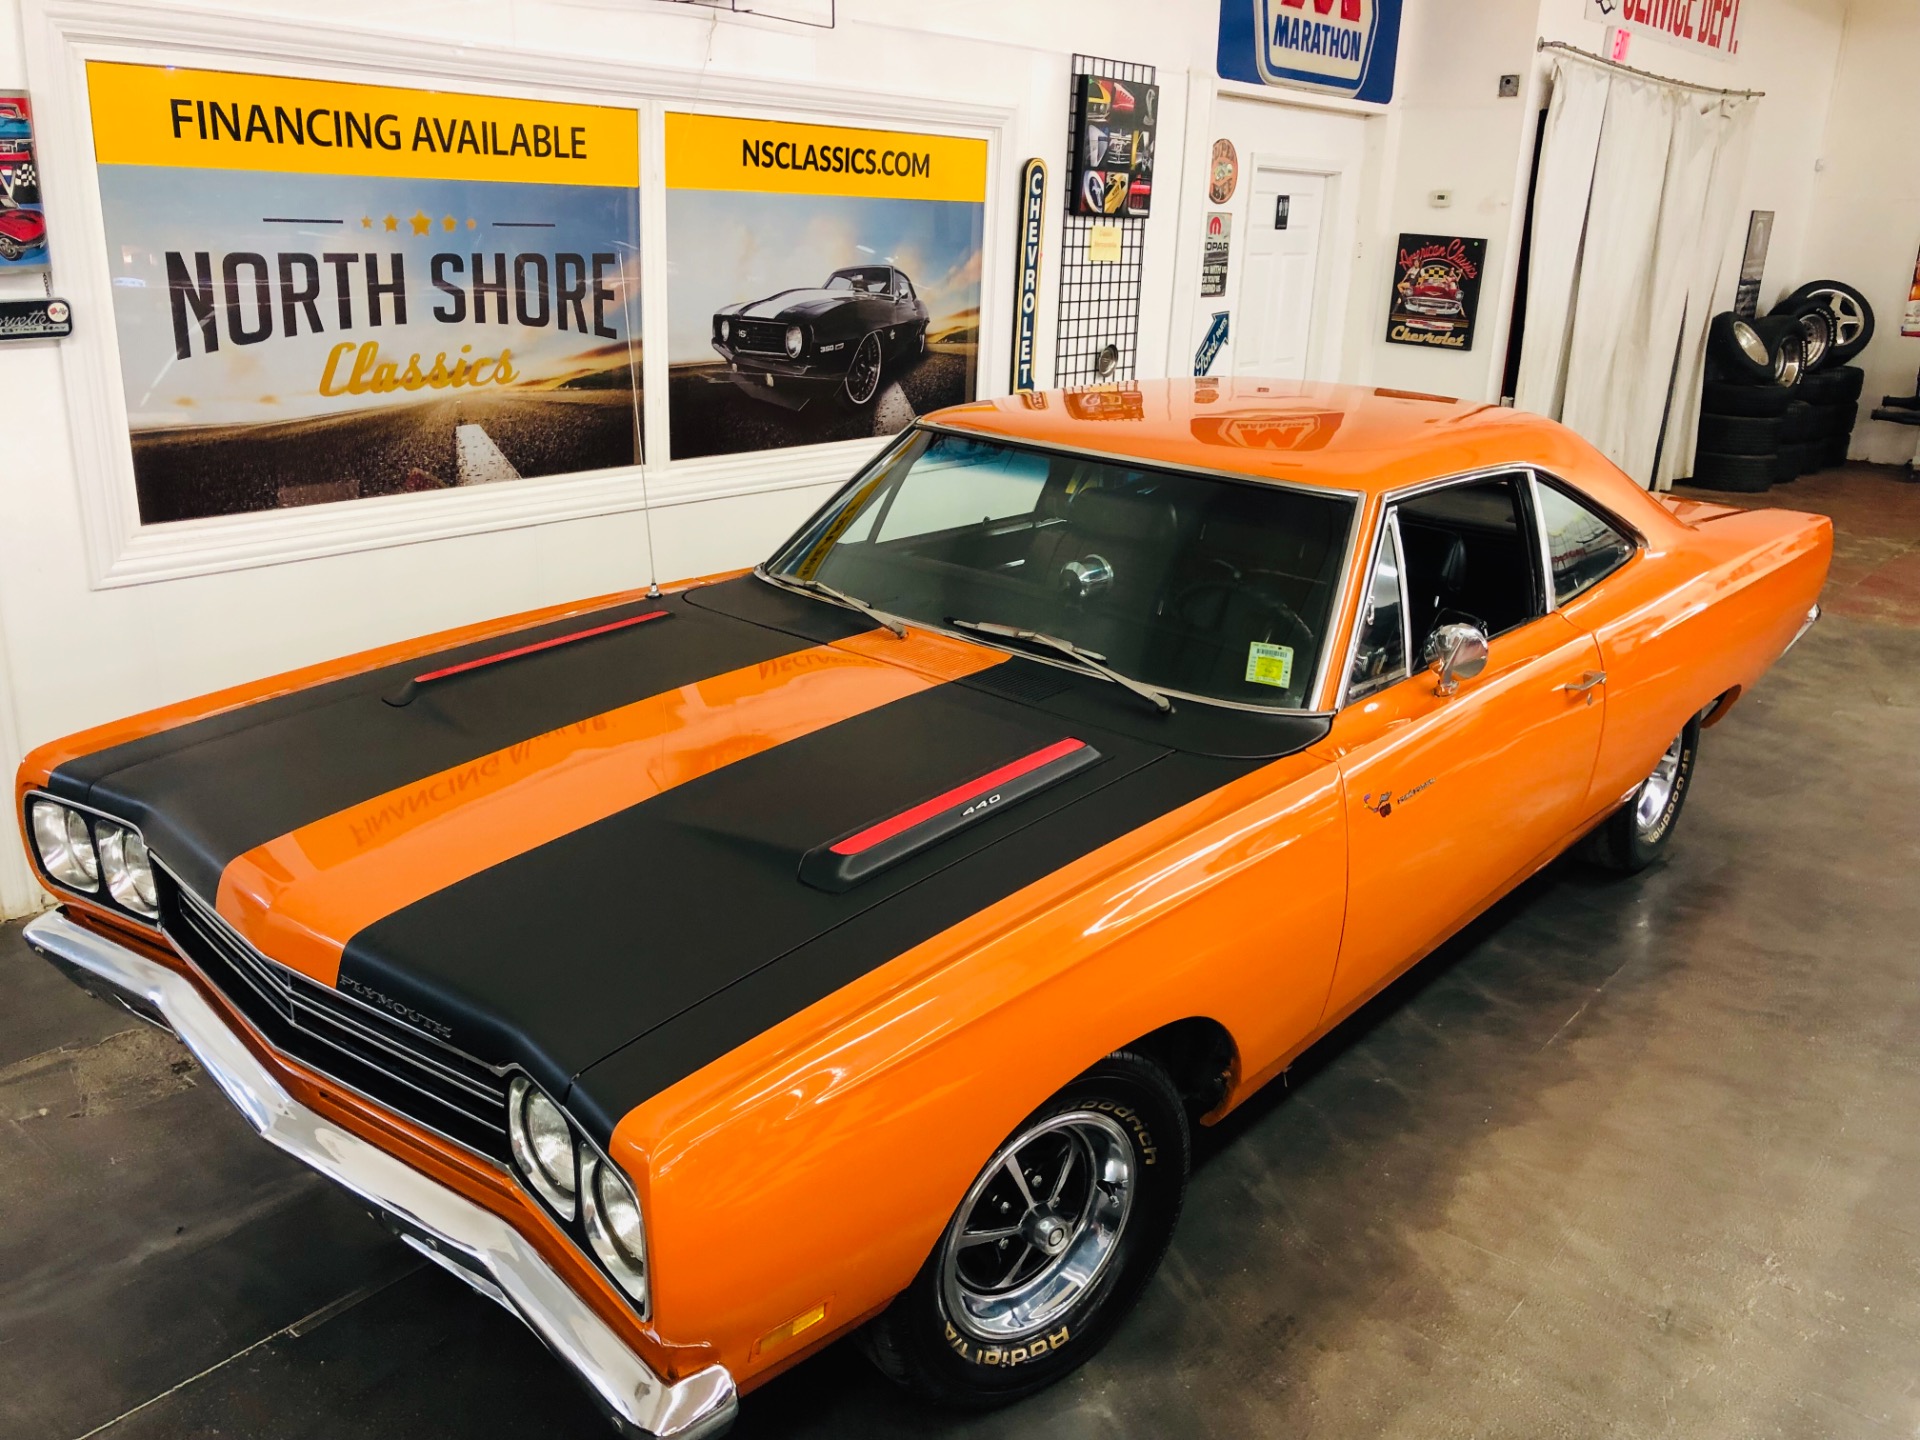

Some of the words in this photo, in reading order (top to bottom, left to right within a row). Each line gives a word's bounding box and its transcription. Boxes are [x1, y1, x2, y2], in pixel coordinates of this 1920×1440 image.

[1273, 14, 1362, 62] MARATHON
[170, 98, 402, 150] FINANCING
[411, 116, 588, 160] AVAILABLE
[742, 138, 930, 178] NSCLASSICS.COM
[1205, 242, 1229, 251] OPAR
[1399, 242, 1447, 271] American
[1446, 238, 1478, 279] Classics
[1020, 171, 1043, 385] CHEVROLET
[0, 310, 50, 326] orvette
[165, 251, 407, 361] NORTH
[430, 252, 618, 340] SHORE
[1391, 325, 1466, 347] Chevrolet
[318, 340, 520, 398] Classics
[962, 793, 1001, 816] 440
[340, 973, 454, 1039] PLYMOUTH
[975, 1325, 1071, 1368] Radial
